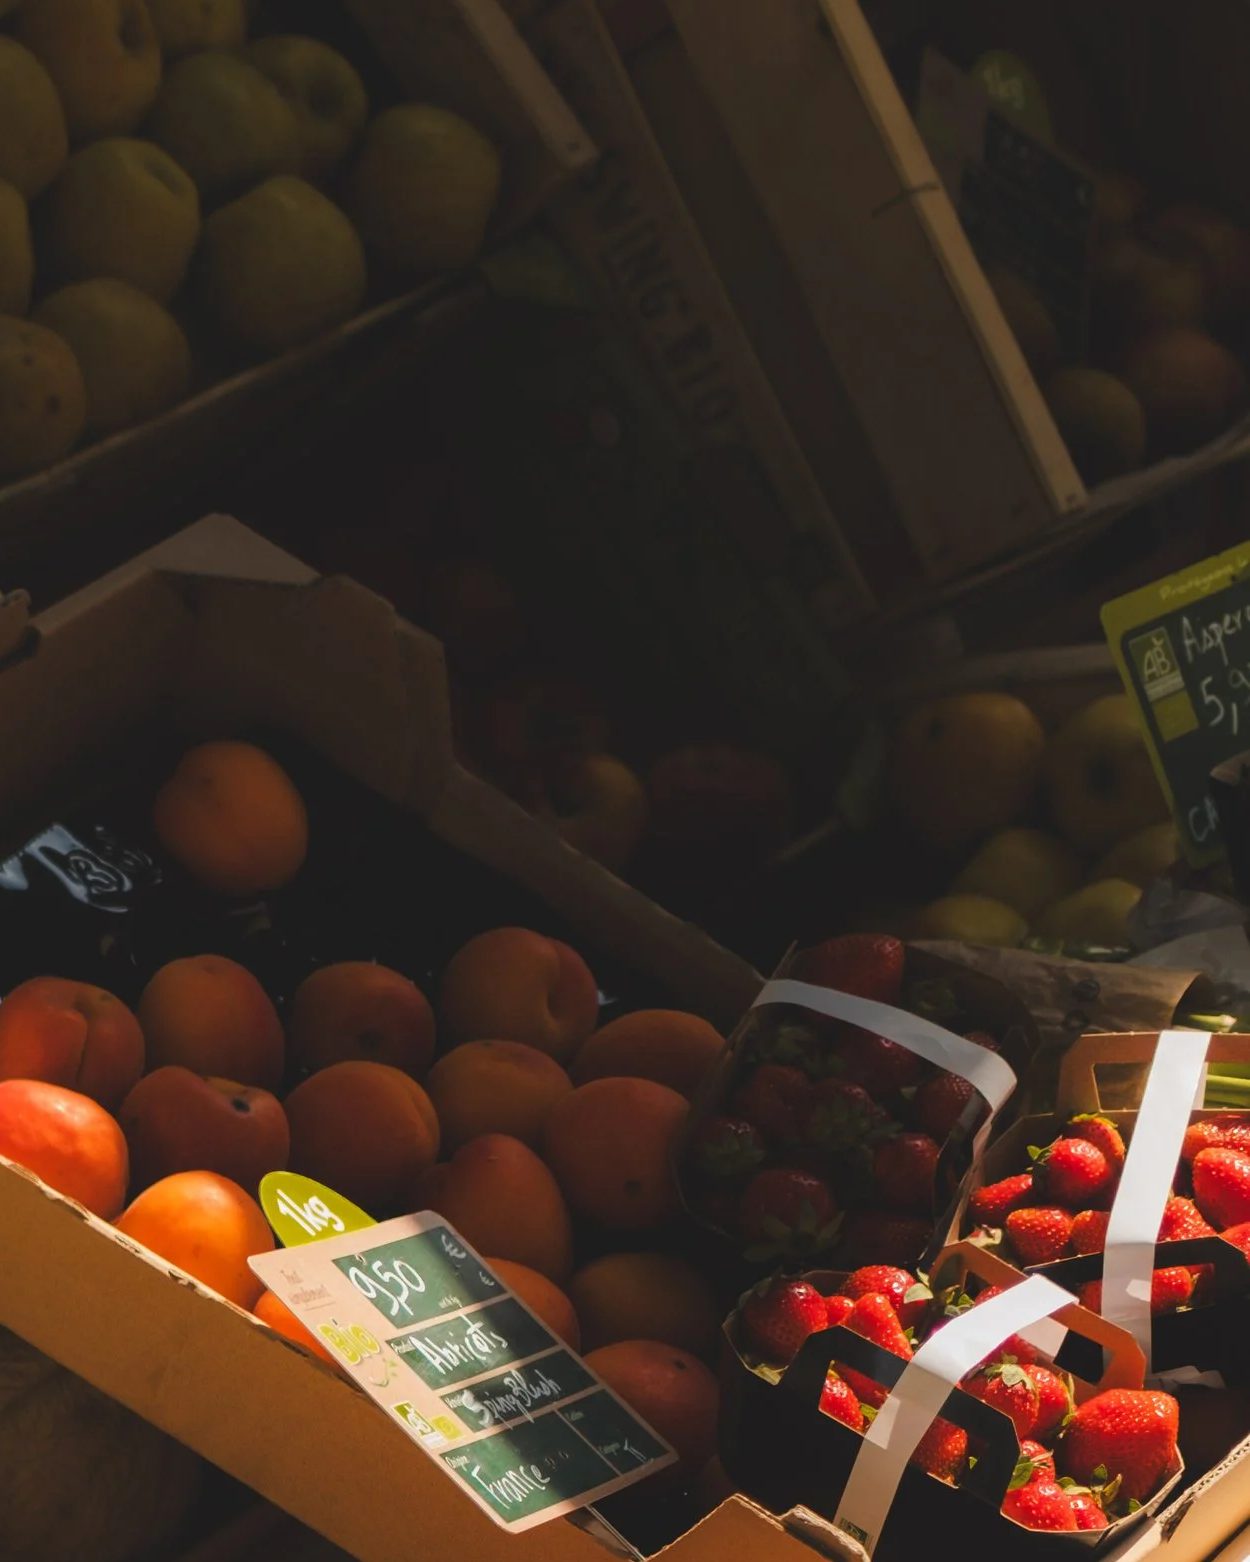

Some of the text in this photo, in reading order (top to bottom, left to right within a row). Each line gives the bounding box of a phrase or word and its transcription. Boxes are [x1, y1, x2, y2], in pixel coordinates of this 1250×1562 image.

[1182, 605, 1250, 666] Asper
[276, 1189, 345, 1236] 1kg
[411, 1313, 508, 1376] Abricots
[470, 1461, 551, 1510] France
